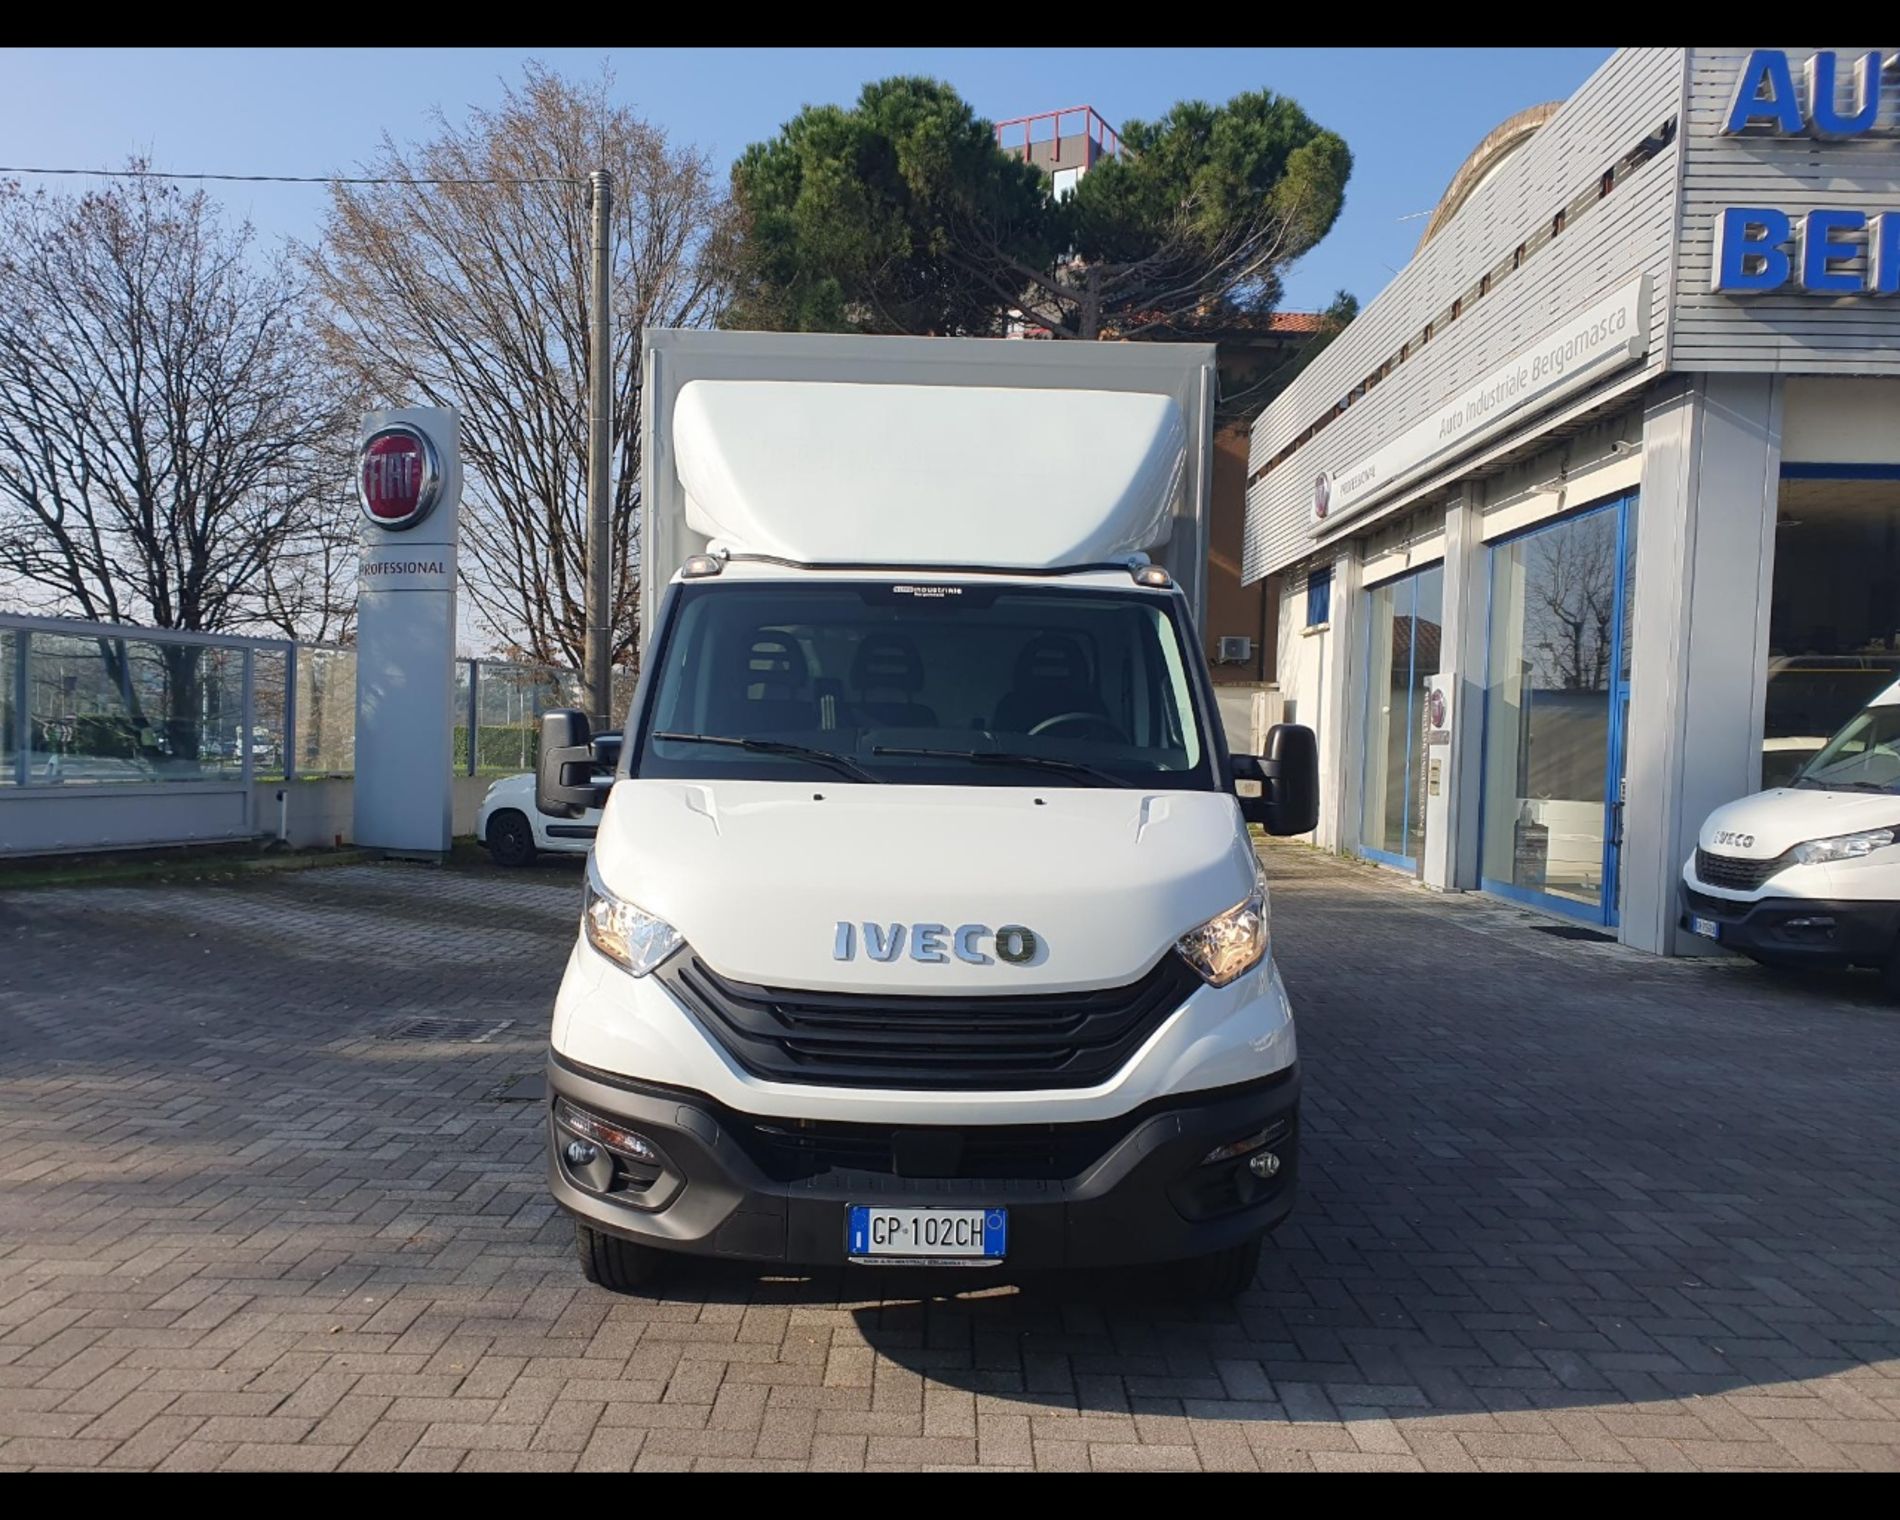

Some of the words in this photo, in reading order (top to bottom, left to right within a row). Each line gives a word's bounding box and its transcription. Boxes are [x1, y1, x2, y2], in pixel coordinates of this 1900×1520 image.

[1719, 49, 1900, 135] AU
[1439, 410, 1463, 439] Auto
[1466, 368, 1528, 422] Industriale
[1532, 306, 1626, 382] Bergamasca
[368, 453, 416, 501] FIAT
[1713, 831, 1755, 848] IVECO
[833, 921, 1037, 964] IVECO
